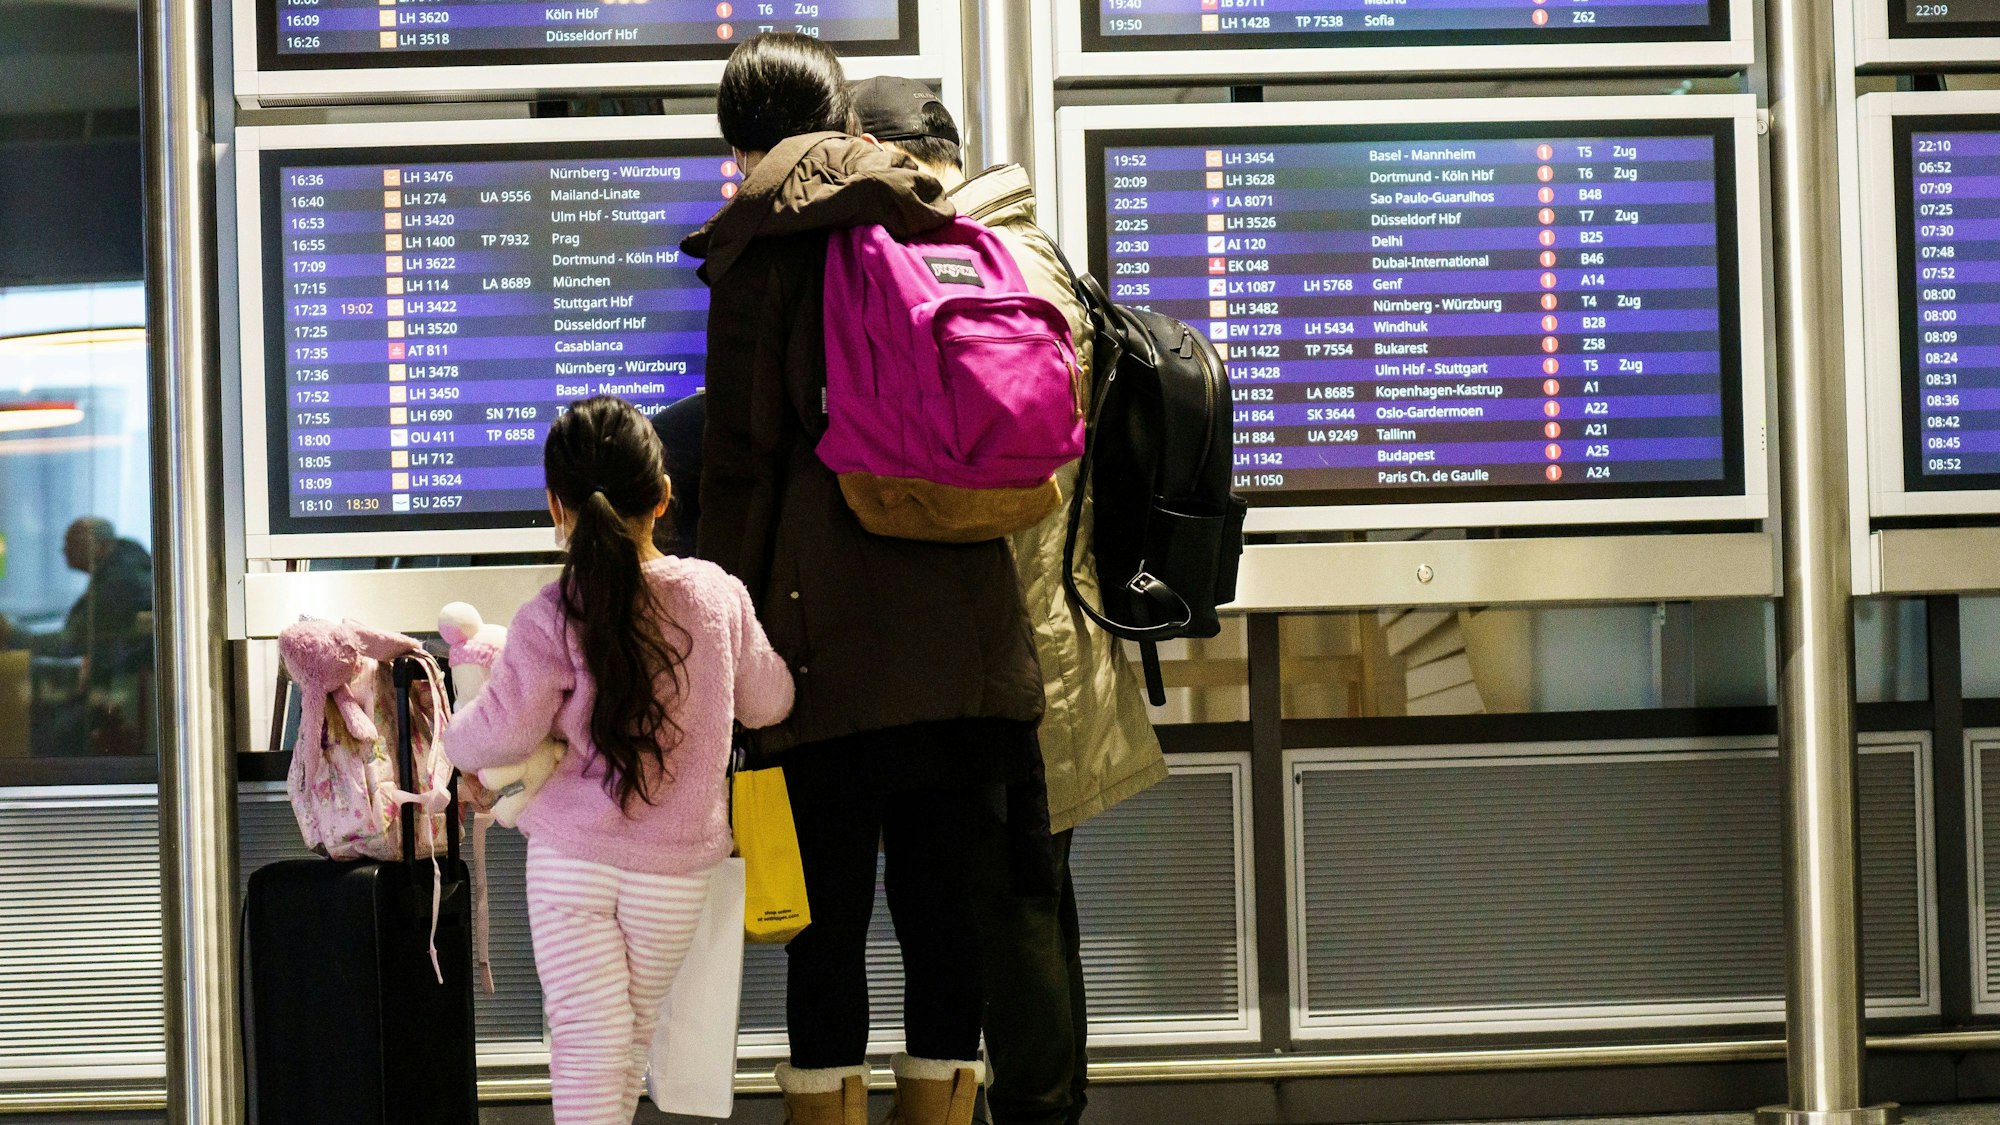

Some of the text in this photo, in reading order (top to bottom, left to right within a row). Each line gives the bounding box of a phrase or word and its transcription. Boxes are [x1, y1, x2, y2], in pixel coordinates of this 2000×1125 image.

[286, 3, 818, 26] 16:09 LH 3620 Köln Hbf T6 Zug
[1915, 4, 1948, 16] 22:09
[1109, 11, 1595, 30] 19:50 LH 1428 TP 7538 Sofia Z62
[286, 27, 638, 48] 16:26 LH 3518 Düsseldorf Hbf
[1918, 140, 1951, 152] 22:10
[1919, 161, 1951, 173] 06:52
[291, 188, 640, 207] 16:40 LH 274 UA 9556 Mailand-Linate
[1919, 182, 1952, 194] 07:09
[1114, 188, 1602, 209] 20:25 LA 8071 Sao Paulo-Guarulhos B48
[1920, 203, 1953, 215] 07:25
[1114, 209, 1638, 231] 20:25 LH 3526 Düsseldorf Hbf T7 Zug
[1921, 224, 1954, 236] 07:30
[292, 232, 579, 251] 16:55 LH 1400 TP 7932 Prag
[1115, 231, 1603, 252] 20:30 AI 120 Delhi B25
[1921, 246, 1954, 258] 07:48
[1922, 267, 1955, 279] 07:52
[293, 275, 610, 294] 17:15 LH 114 LA 8689 München
[1116, 273, 1604, 295] 20:35 LX 1087 LH 5768 Genf A14
[1923, 288, 1956, 300] 08:00
[294, 295, 633, 316] 17:23 19:02 LH 3422 Stuttgart Hbf
[294, 316, 646, 338] 17:25 LH 3520 Düsseldorf Hbf
[1230, 316, 1606, 336] EW 1278 LH 5434 Windhuk B28
[1924, 330, 1957, 343] 08:09
[295, 339, 623, 359] 17:35 AT 811 Casablanca
[1230, 337, 1605, 358] LH 1422 TP 7554 Bukarest Z58
[1925, 352, 1958, 364] 08:24
[1231, 380, 1598, 401] LH 832 LA 8685 Kopenhagen-Kastrup A1
[1926, 394, 1959, 406] 08:36
[297, 406, 536, 424] 17:55 LH 690 SN 7169
[1233, 401, 1608, 422] LH 864 SK 3644 Oslo-Gardermoen A22
[297, 428, 535, 446] 18:00 OU 411 TP 6858
[1233, 423, 1607, 444] LH 884 UA 9249 Tallinn A21
[1928, 436, 1960, 448] 08:45
[1233, 444, 1609, 465] LH 1342 Budapest A25
[1928, 458, 1961, 470] 08:52
[1234, 466, 1610, 486] LH 1050 Paris Ch. de Gaulle A24
[299, 495, 462, 511] 18:10 18:30 SU 2657
